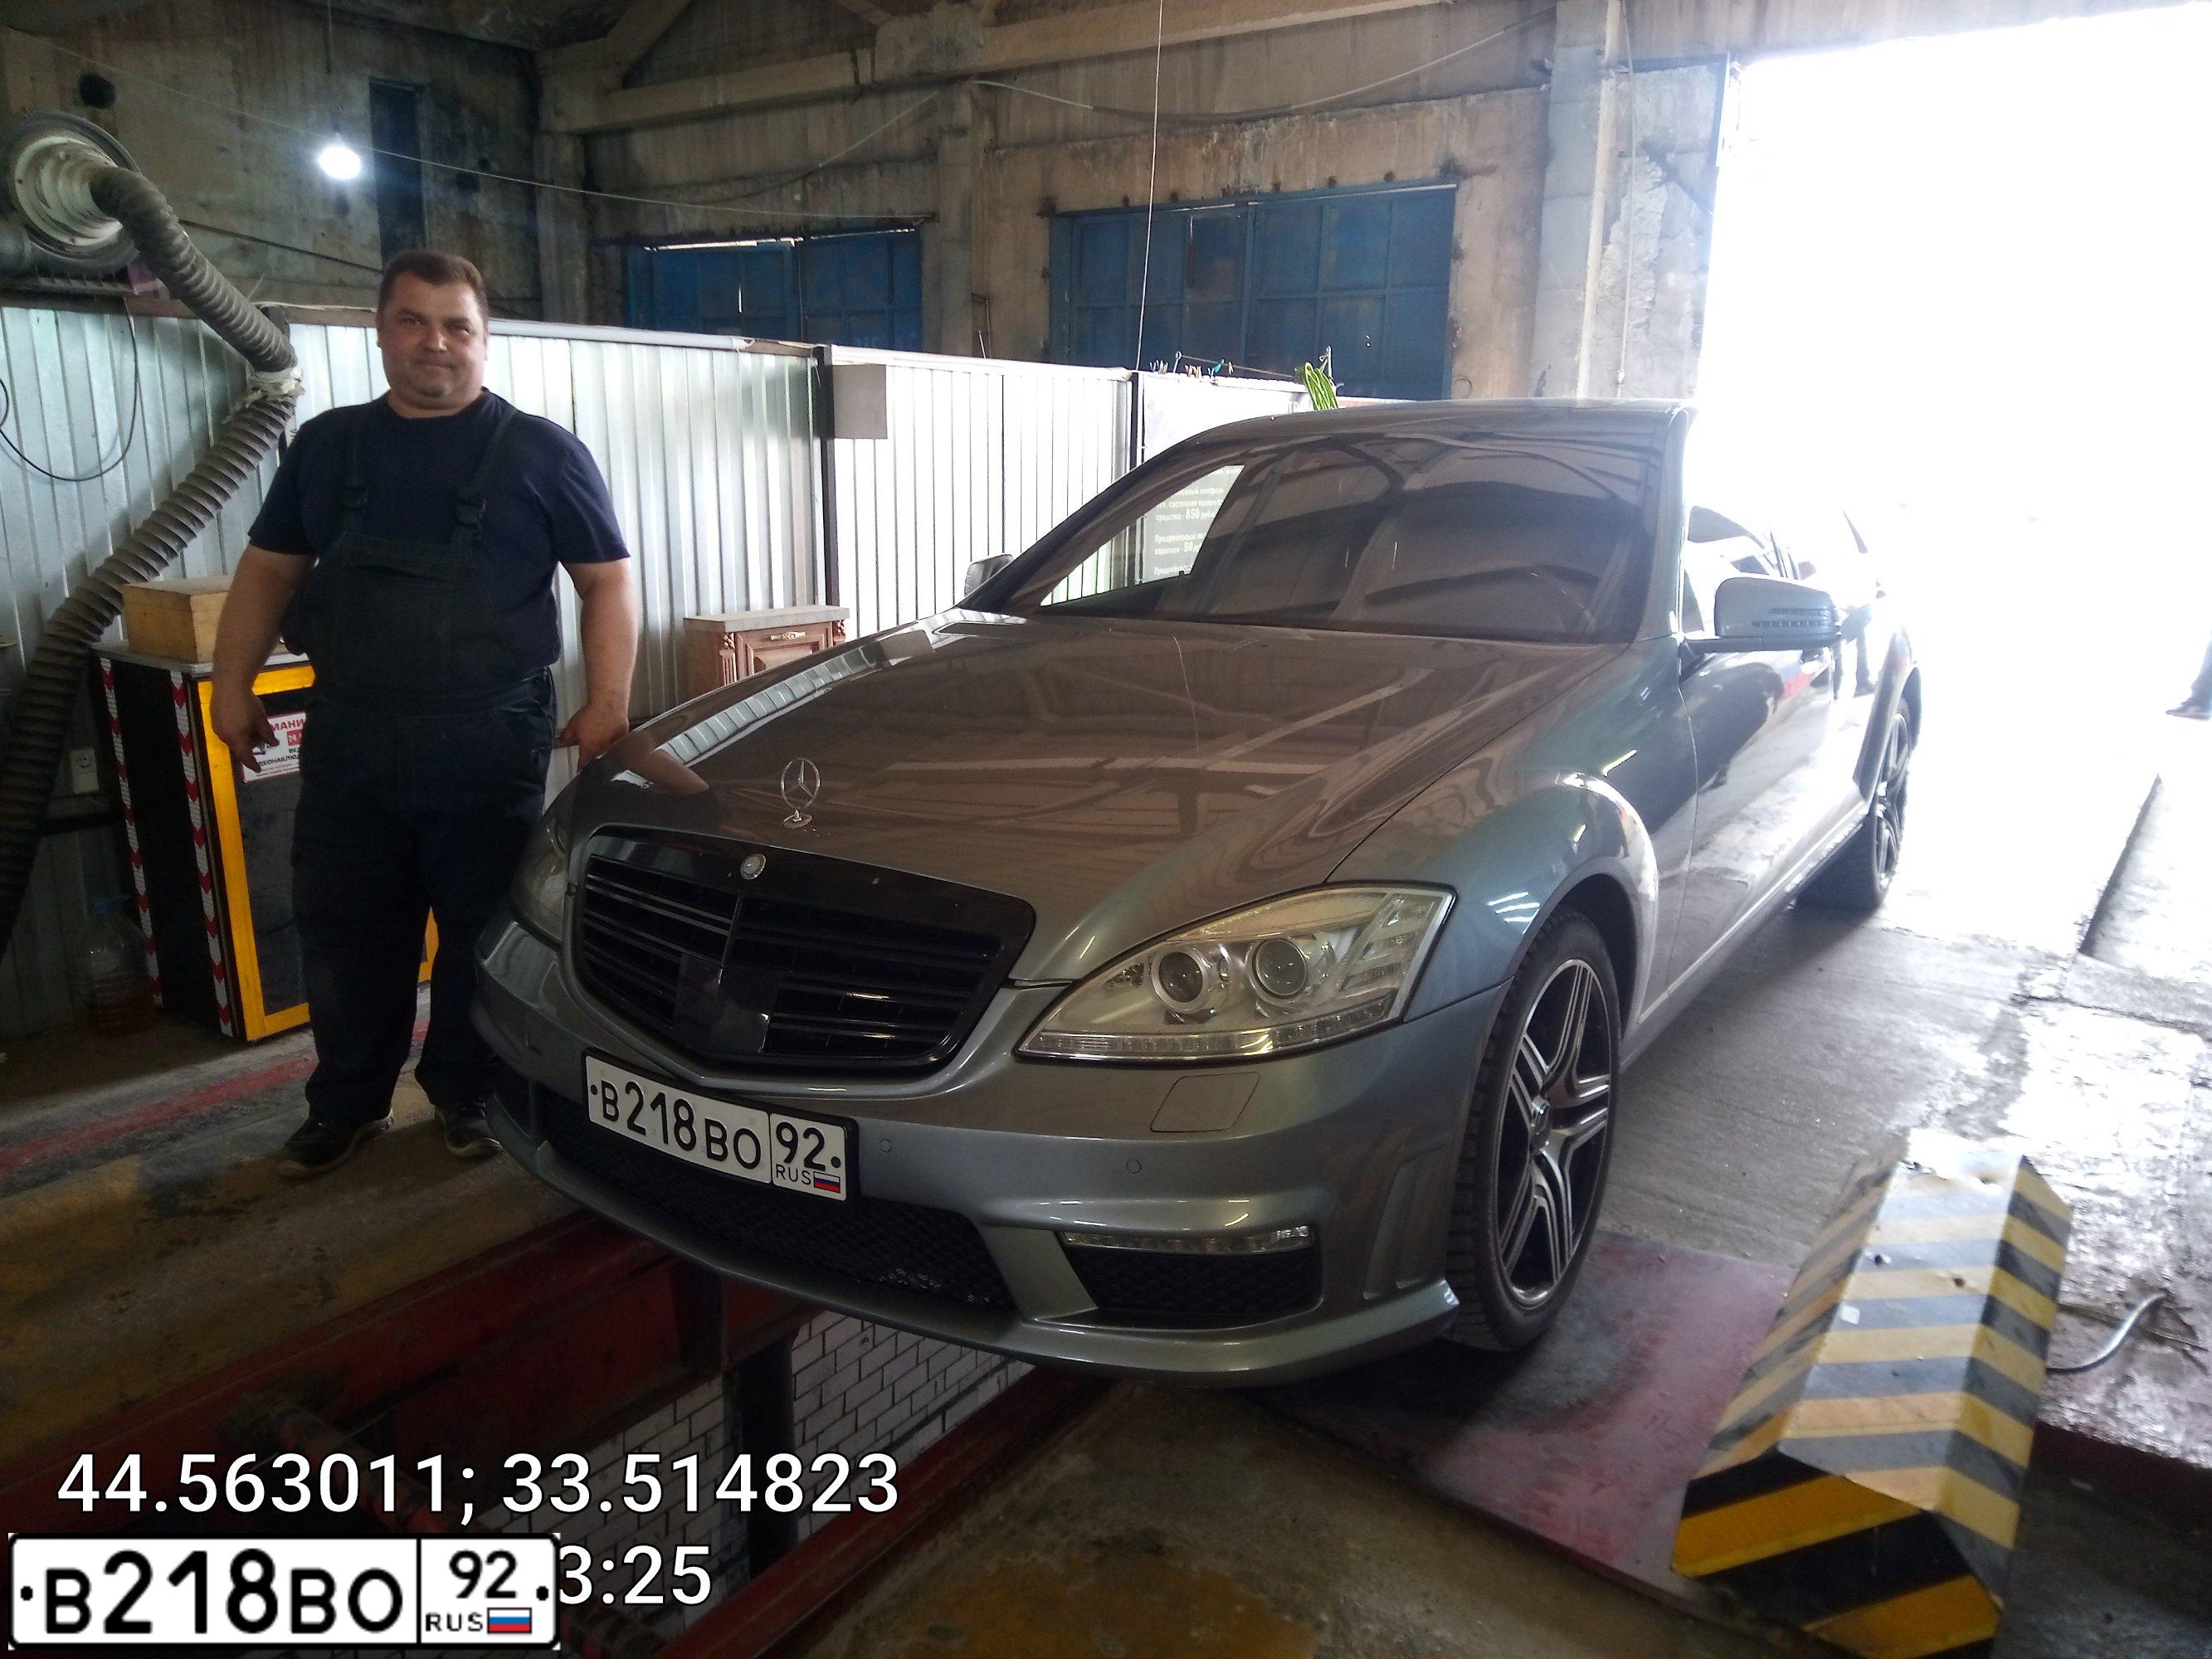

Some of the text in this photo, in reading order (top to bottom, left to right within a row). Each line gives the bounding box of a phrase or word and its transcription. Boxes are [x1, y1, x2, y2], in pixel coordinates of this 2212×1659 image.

[1186, 508, 1200, 520] 850
[1184, 541, 1193, 553] 50
[776, 1121, 826, 1172] 92
[776, 1164, 811, 1185] RUS
